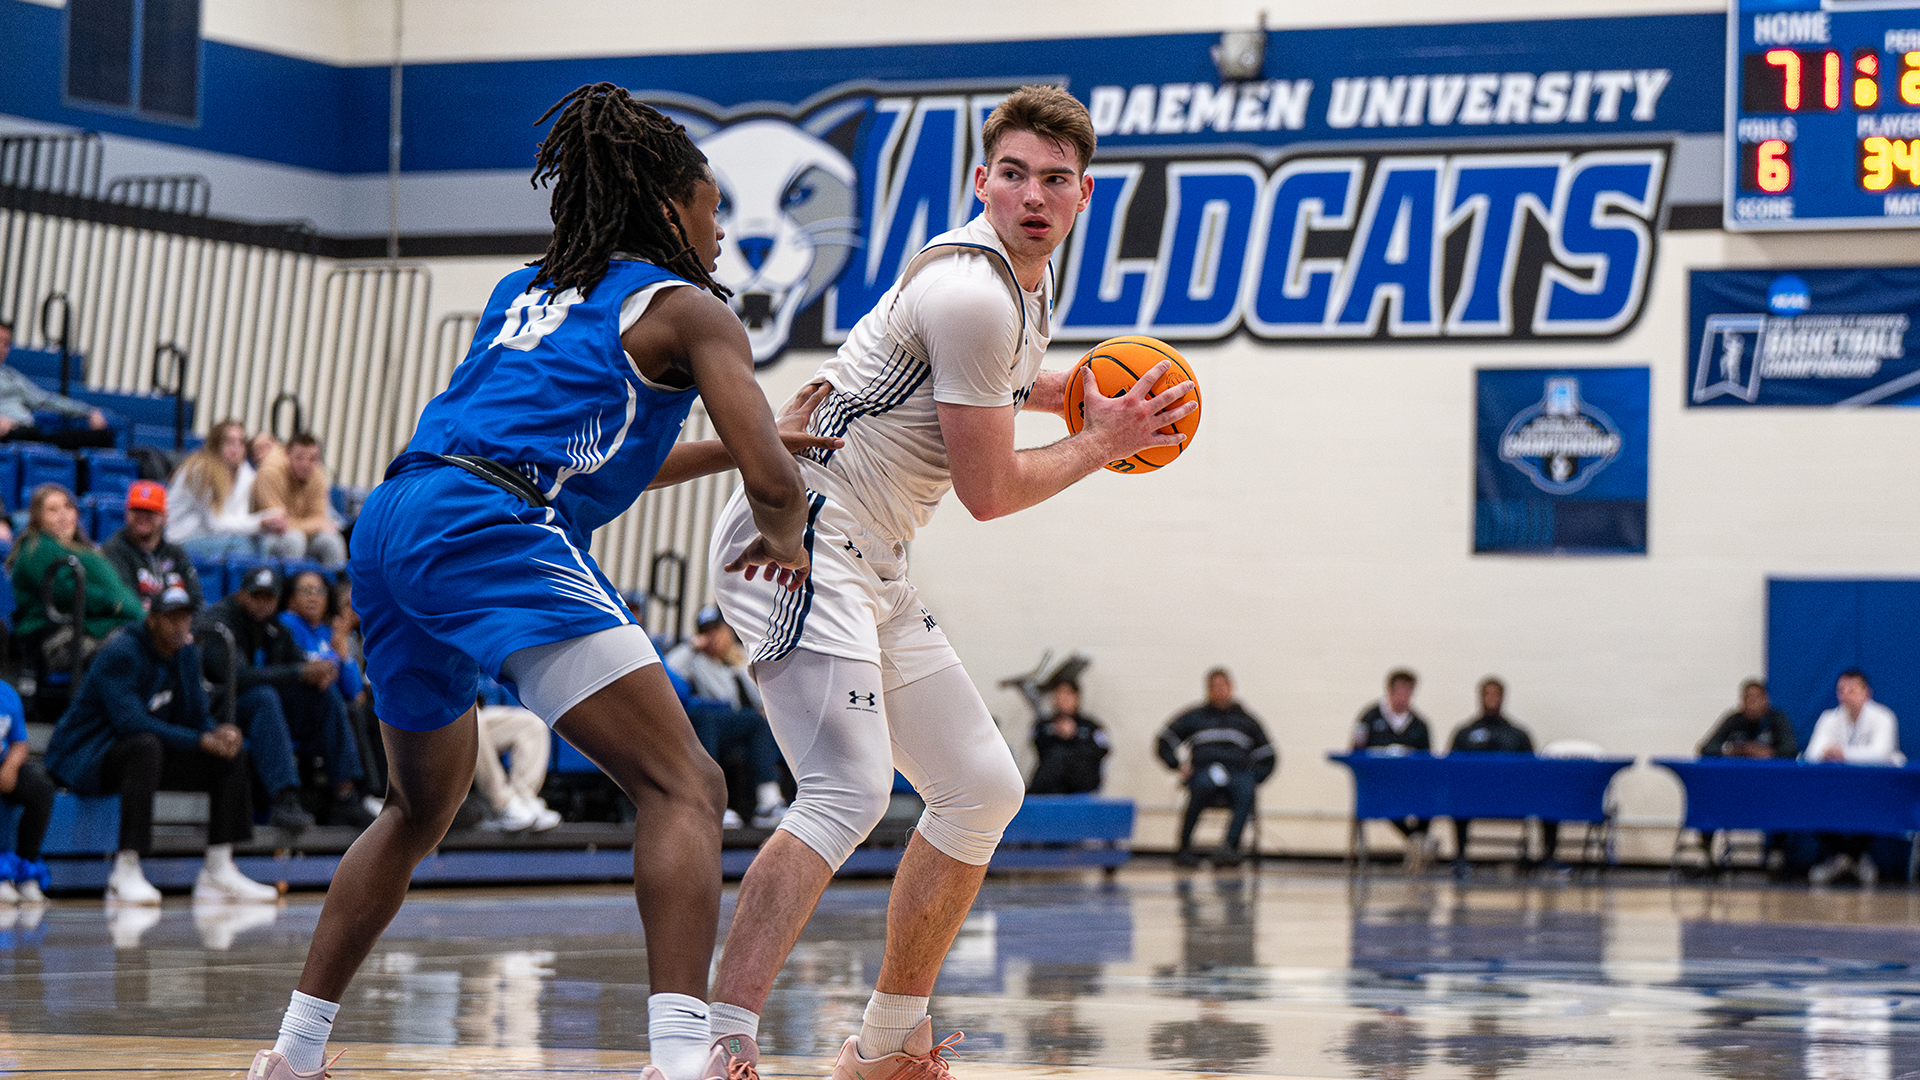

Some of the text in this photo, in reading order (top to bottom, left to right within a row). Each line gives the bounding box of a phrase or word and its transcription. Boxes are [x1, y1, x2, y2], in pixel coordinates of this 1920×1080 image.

[1754, 12, 1831, 45] HOME
[1089, 68, 1672, 136] DAEMEN UNIVERSITY
[1765, 49, 1840, 111] 71
[1738, 117, 1798, 142] FOULS
[1757, 139, 1790, 192] 6
[1863, 136, 1920, 190] 34
[821, 96, 1666, 344] WLDCATS
[1737, 197, 1794, 220] SCORE
